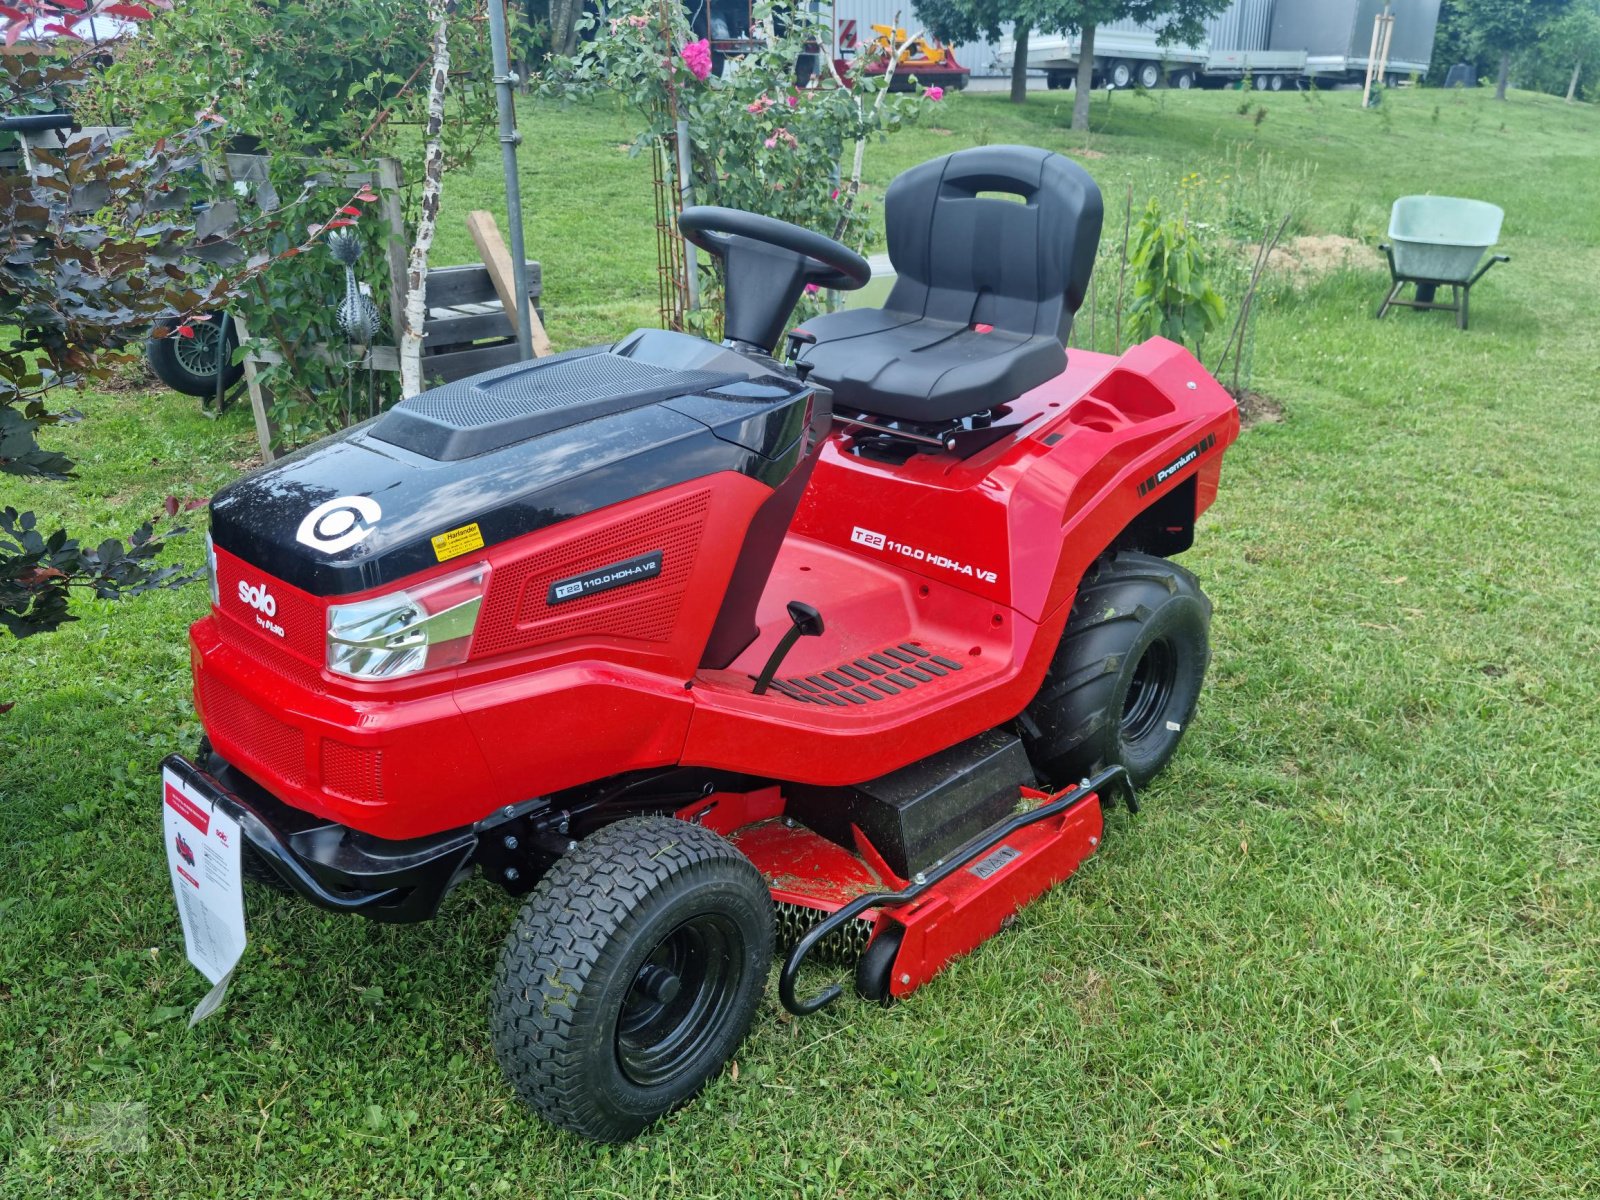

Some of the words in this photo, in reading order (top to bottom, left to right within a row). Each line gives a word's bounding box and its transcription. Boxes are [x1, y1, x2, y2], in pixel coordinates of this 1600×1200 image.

[1157, 450, 1197, 482] Premium
[855, 530, 864, 540] T
[864, 534, 882, 546] 22
[887, 541, 925, 560] 110.0
[926, 553, 973, 576] HDH-A
[976, 568, 998, 584] V2
[566, 585, 581, 593] 22
[584, 576, 611, 588] 110.0
[611, 567, 642, 580] HDH-A
[642, 561, 656, 571] V2
[239, 580, 276, 617] solo
[256, 613, 266, 629] by
